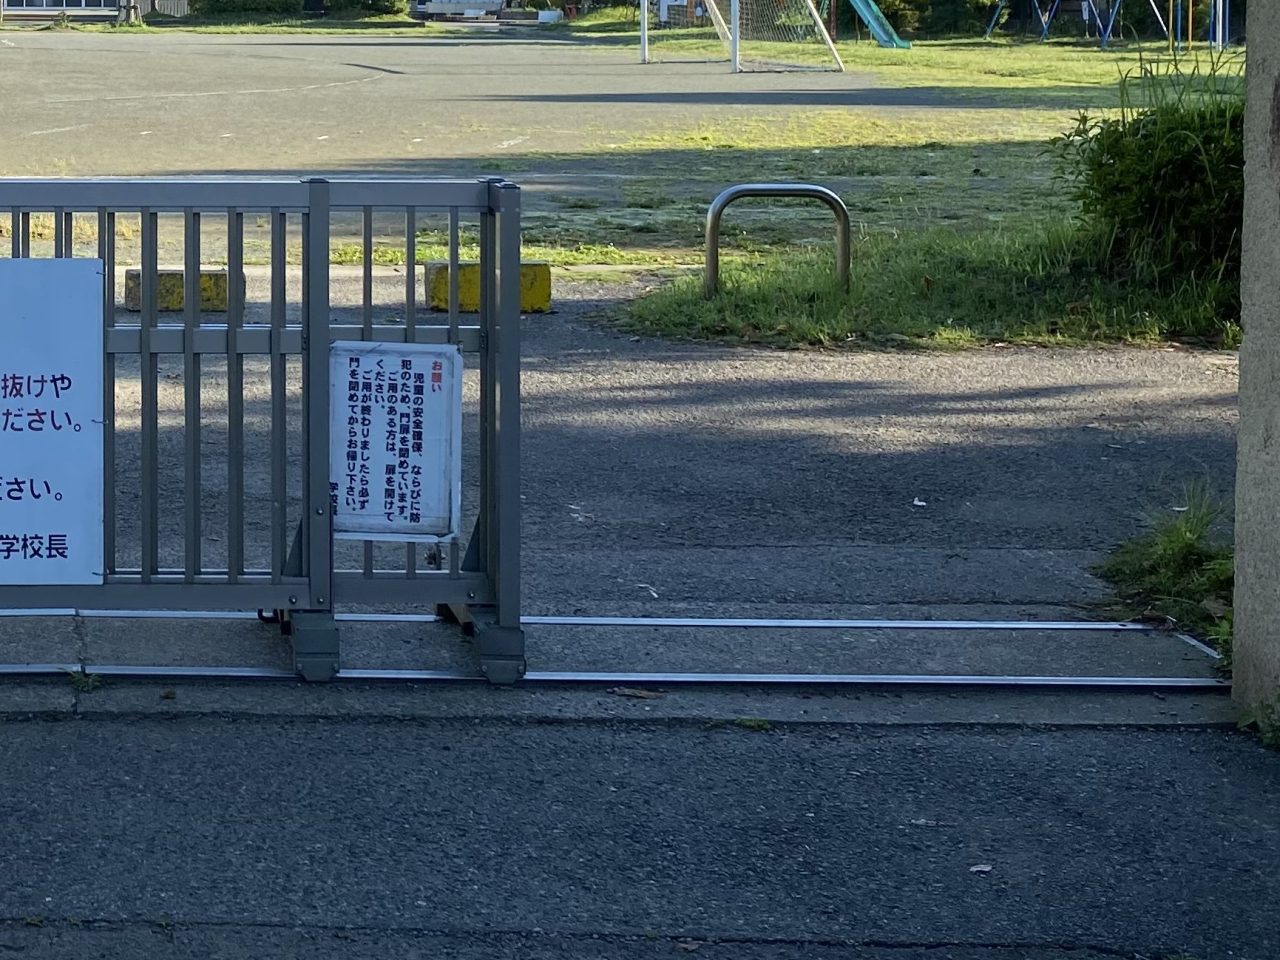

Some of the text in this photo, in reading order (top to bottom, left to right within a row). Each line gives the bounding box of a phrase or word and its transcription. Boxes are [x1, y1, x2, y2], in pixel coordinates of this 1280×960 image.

[374, 359, 386, 410] ください。
[431, 360, 443, 393] お願い
[358, 369, 373, 511] ご用が終わりましたら必ず
